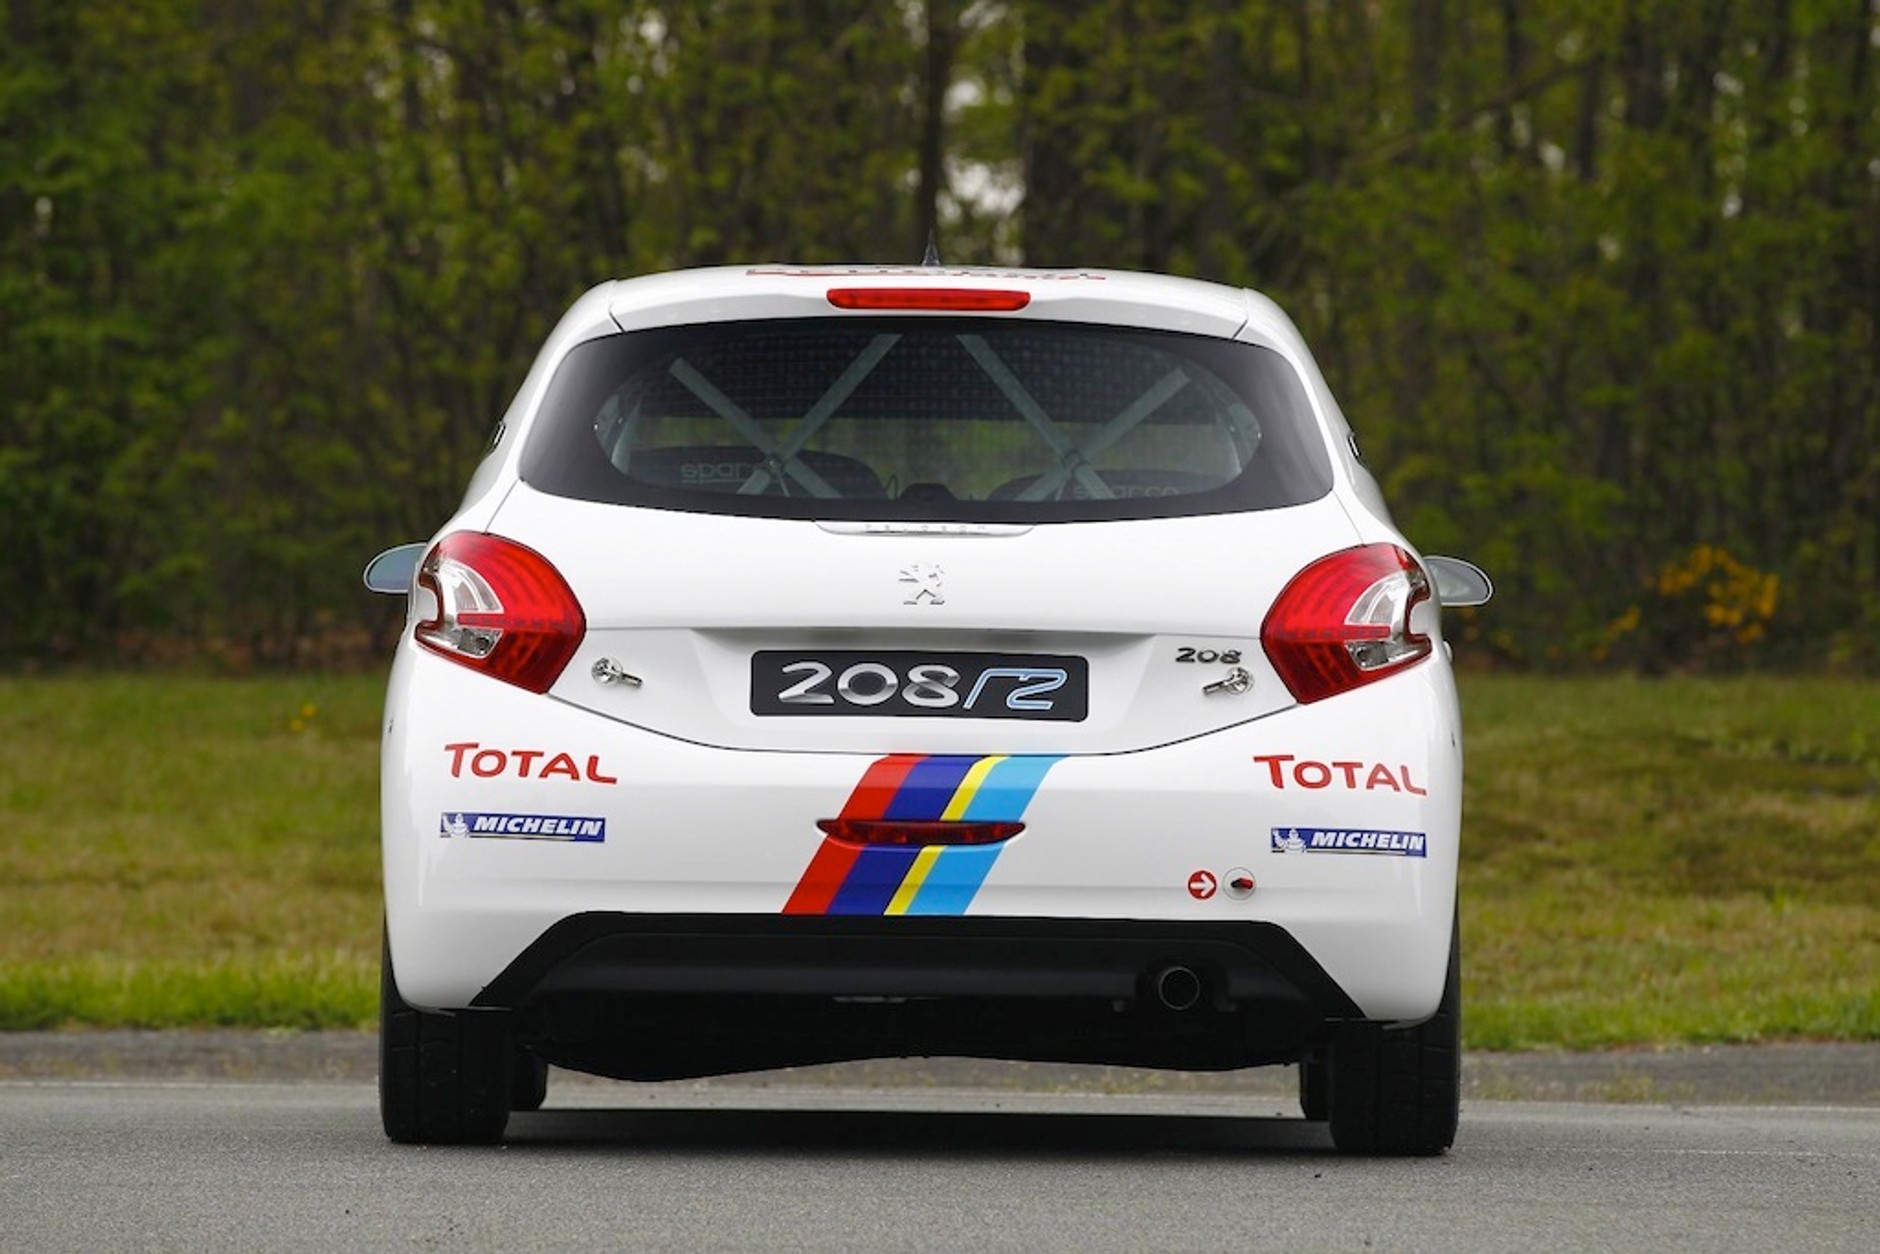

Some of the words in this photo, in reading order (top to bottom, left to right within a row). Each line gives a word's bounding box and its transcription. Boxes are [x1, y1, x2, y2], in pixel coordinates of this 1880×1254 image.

[680, 462, 755, 484] spar
[1175, 647, 1242, 664] 208
[444, 742, 618, 785] TOTAL
[1253, 755, 1427, 796] TOTAL
[473, 816, 603, 836] MICHELIN
[1311, 831, 1425, 851] MICHELIN
